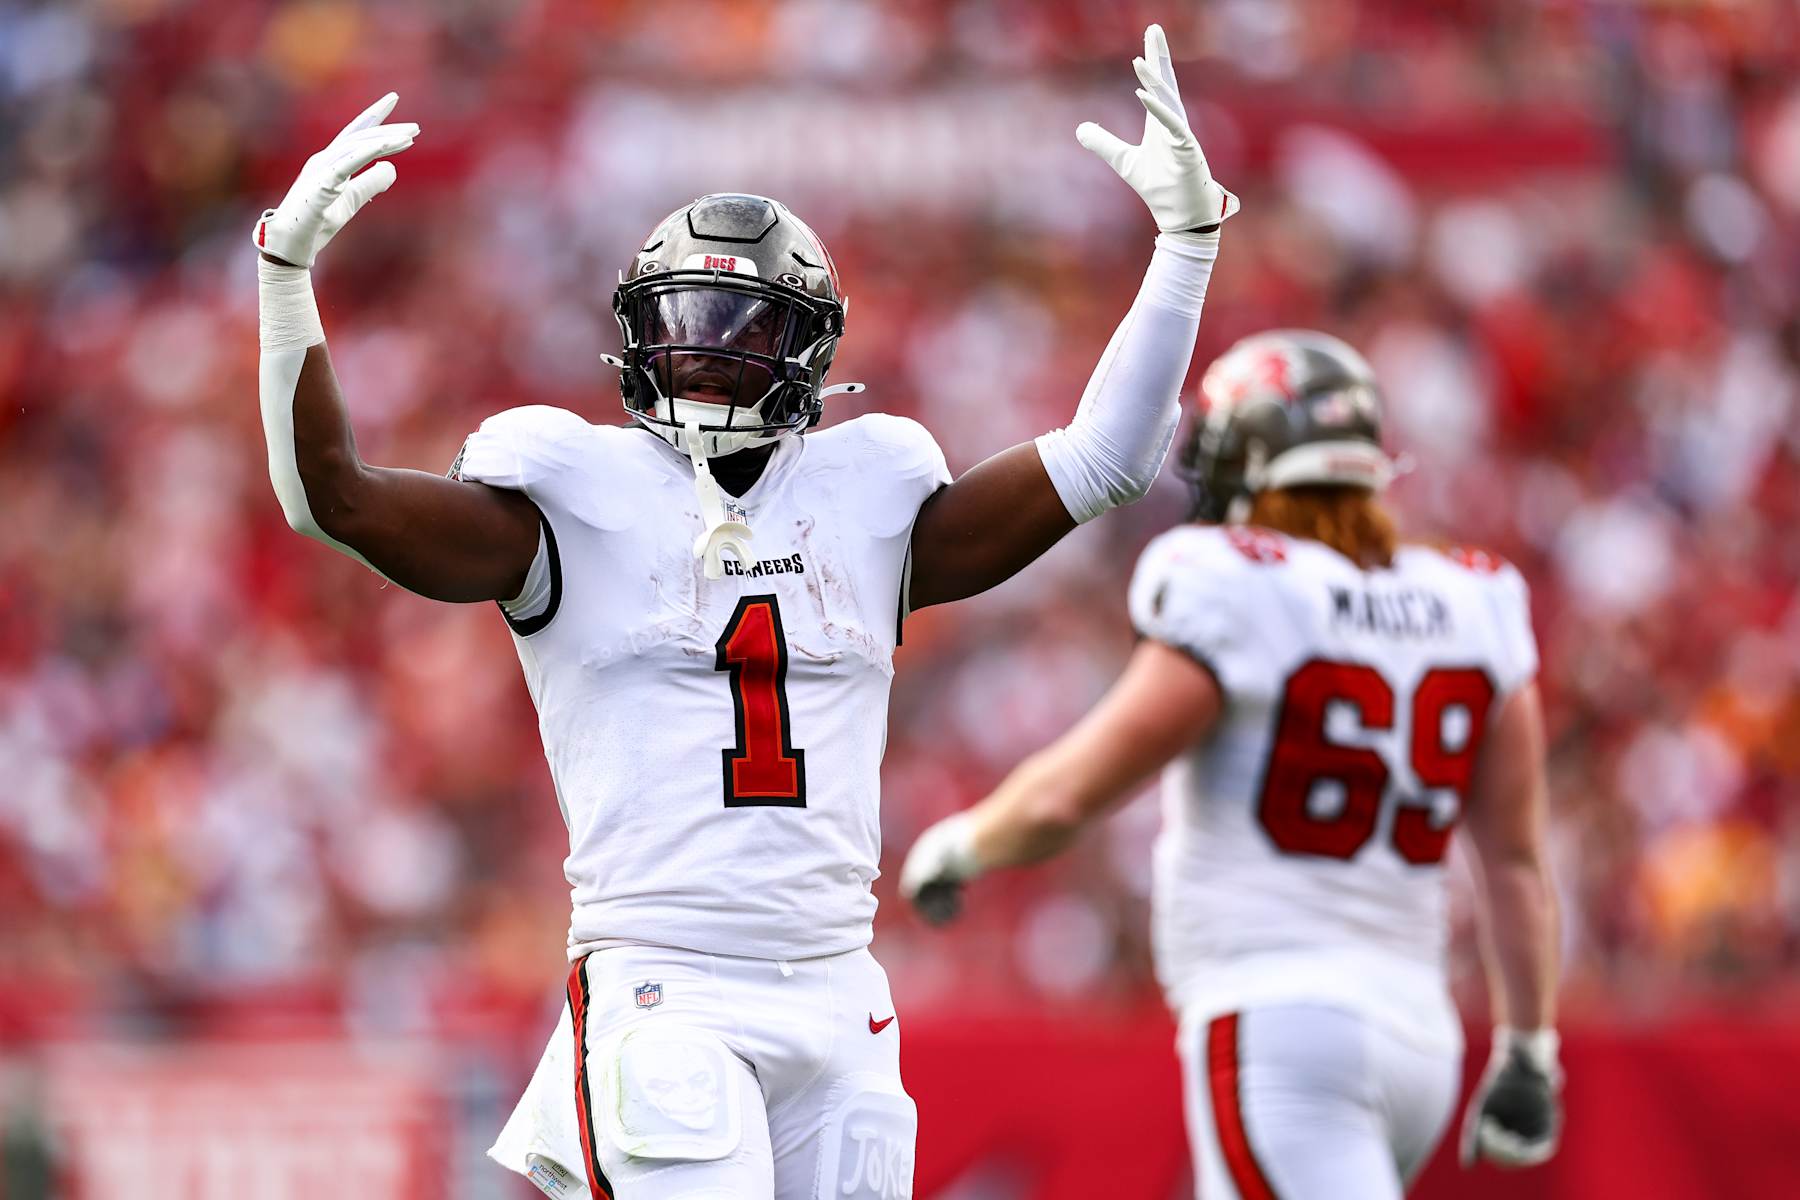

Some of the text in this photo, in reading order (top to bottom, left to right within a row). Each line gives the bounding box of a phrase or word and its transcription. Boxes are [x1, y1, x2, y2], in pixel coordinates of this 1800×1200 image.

[704, 255, 736, 271] BUCS
[702, 553, 804, 580] CCNEERS
[715, 594, 807, 808] 1
[1256, 656, 1496, 866] 69
[638, 992, 658, 1004] NFL
[541, 1165, 567, 1190] northwest
